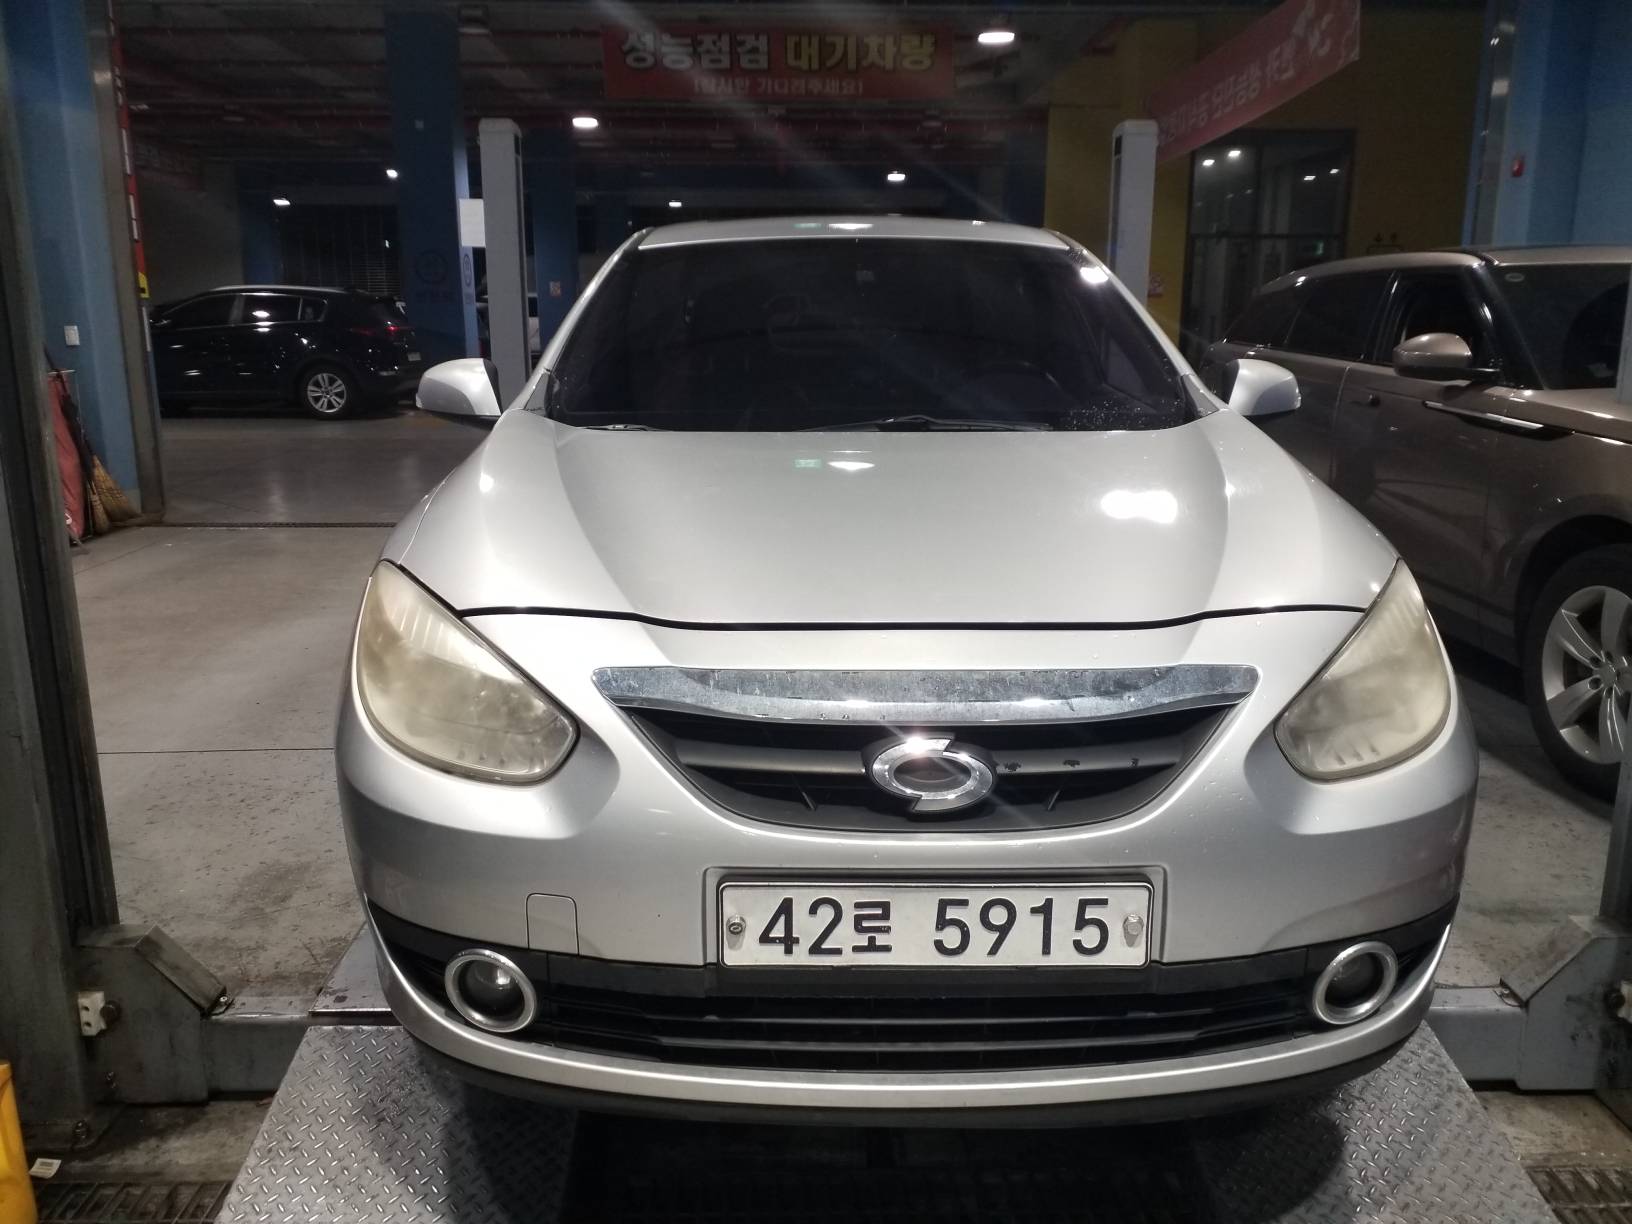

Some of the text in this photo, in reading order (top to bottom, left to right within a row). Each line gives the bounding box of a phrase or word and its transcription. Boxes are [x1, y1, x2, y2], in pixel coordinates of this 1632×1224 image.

[622, 31, 937, 71] 성능점검 대기차량
[758, 896, 1110, 956] 42로 5915
